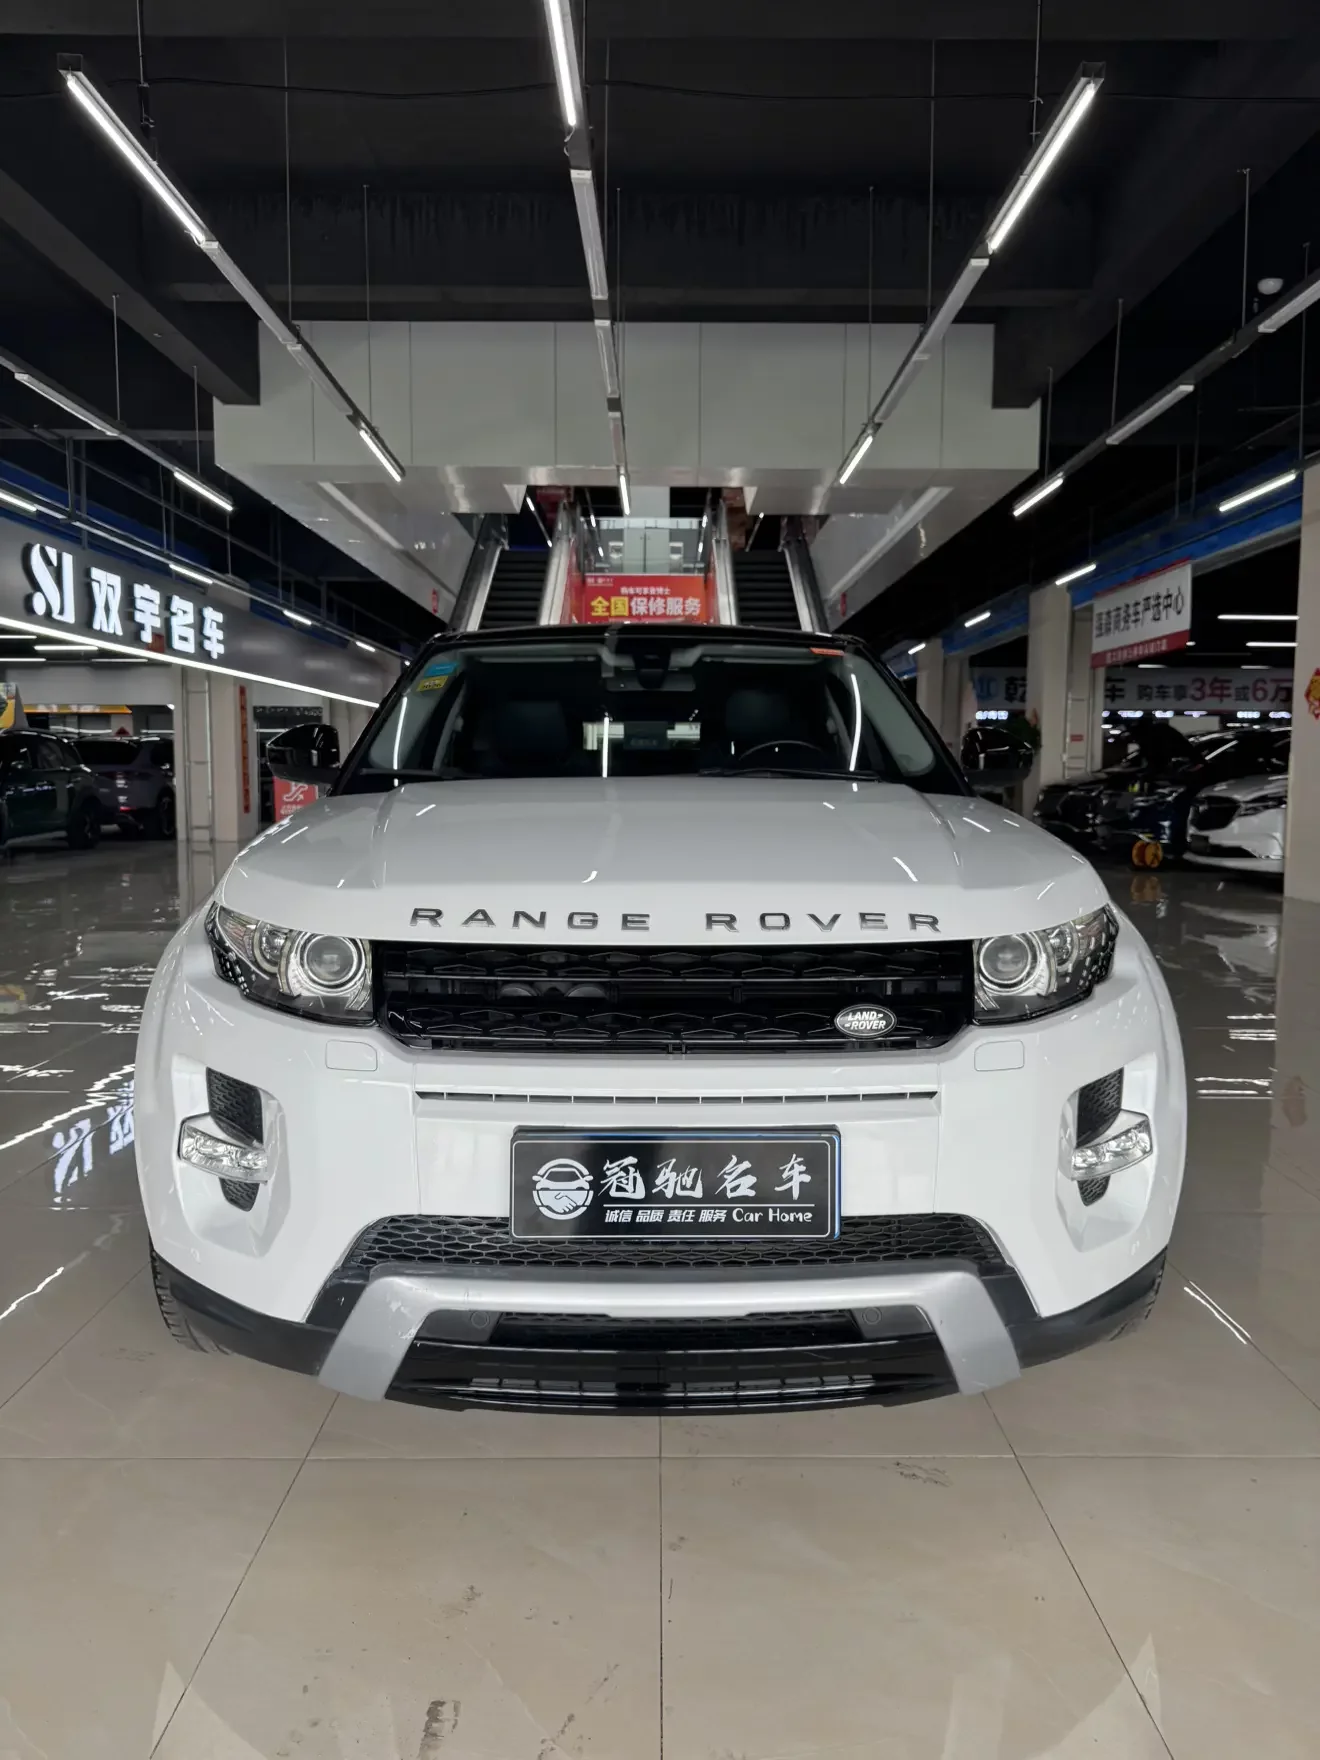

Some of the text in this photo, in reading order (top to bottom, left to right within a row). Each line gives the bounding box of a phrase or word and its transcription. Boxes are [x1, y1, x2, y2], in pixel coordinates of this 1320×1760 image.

[90, 566, 225, 660] 双宇名车
[590, 596, 702, 616] 全国保修服务
[409, 908, 942, 933] RANGE ROVER
[850, 1020, 887, 1030] ROVER
[598, 1154, 812, 1200] 冠驰名车
[605, 1208, 813, 1223] 诚信 品质 责任 服务 Car Home
